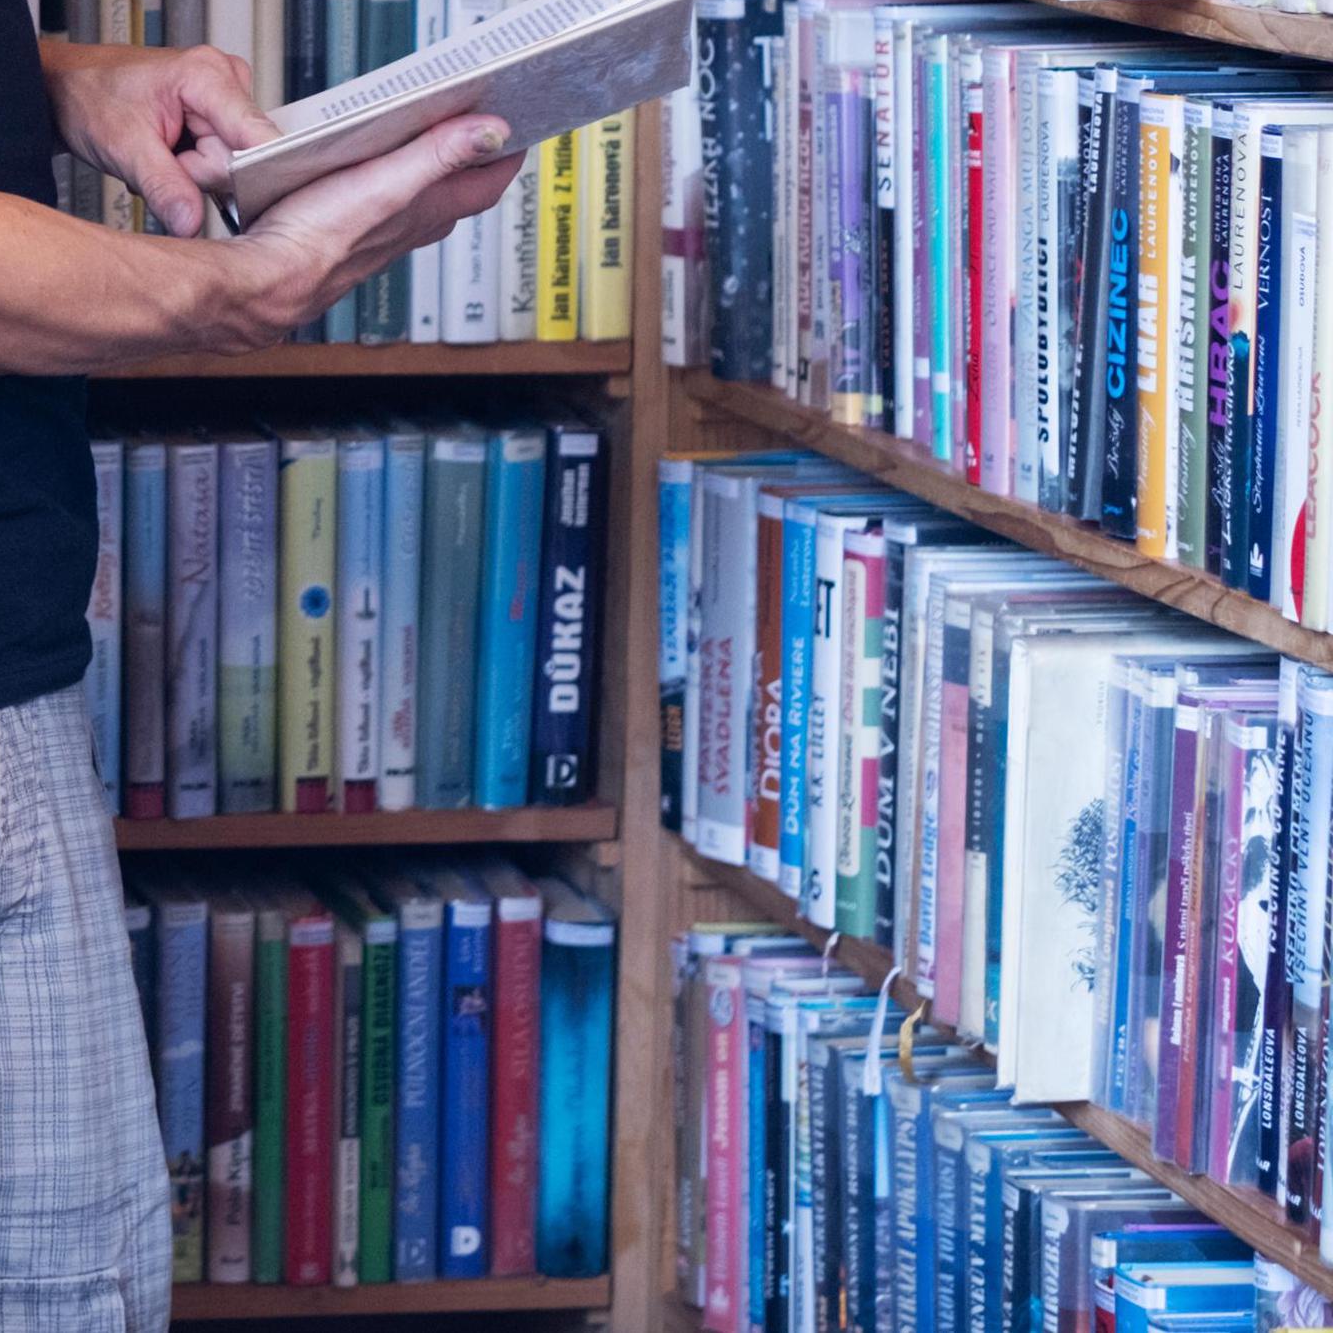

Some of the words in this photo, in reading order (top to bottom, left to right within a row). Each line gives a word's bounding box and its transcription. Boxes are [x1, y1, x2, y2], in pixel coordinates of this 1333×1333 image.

[598, 139, 623, 231] Karonová
[1214, 155, 1223, 243] CHRISTINA
[547, 203, 572, 288] Karonová
[599, 237, 622, 268] Jan
[549, 292, 571, 322] Jan
[1106, 208, 1129, 400] CIZINEC
[542, 565, 586, 714] DŮKAZ
[786, 732, 801, 770] NA
[920, 883, 934, 947] David
